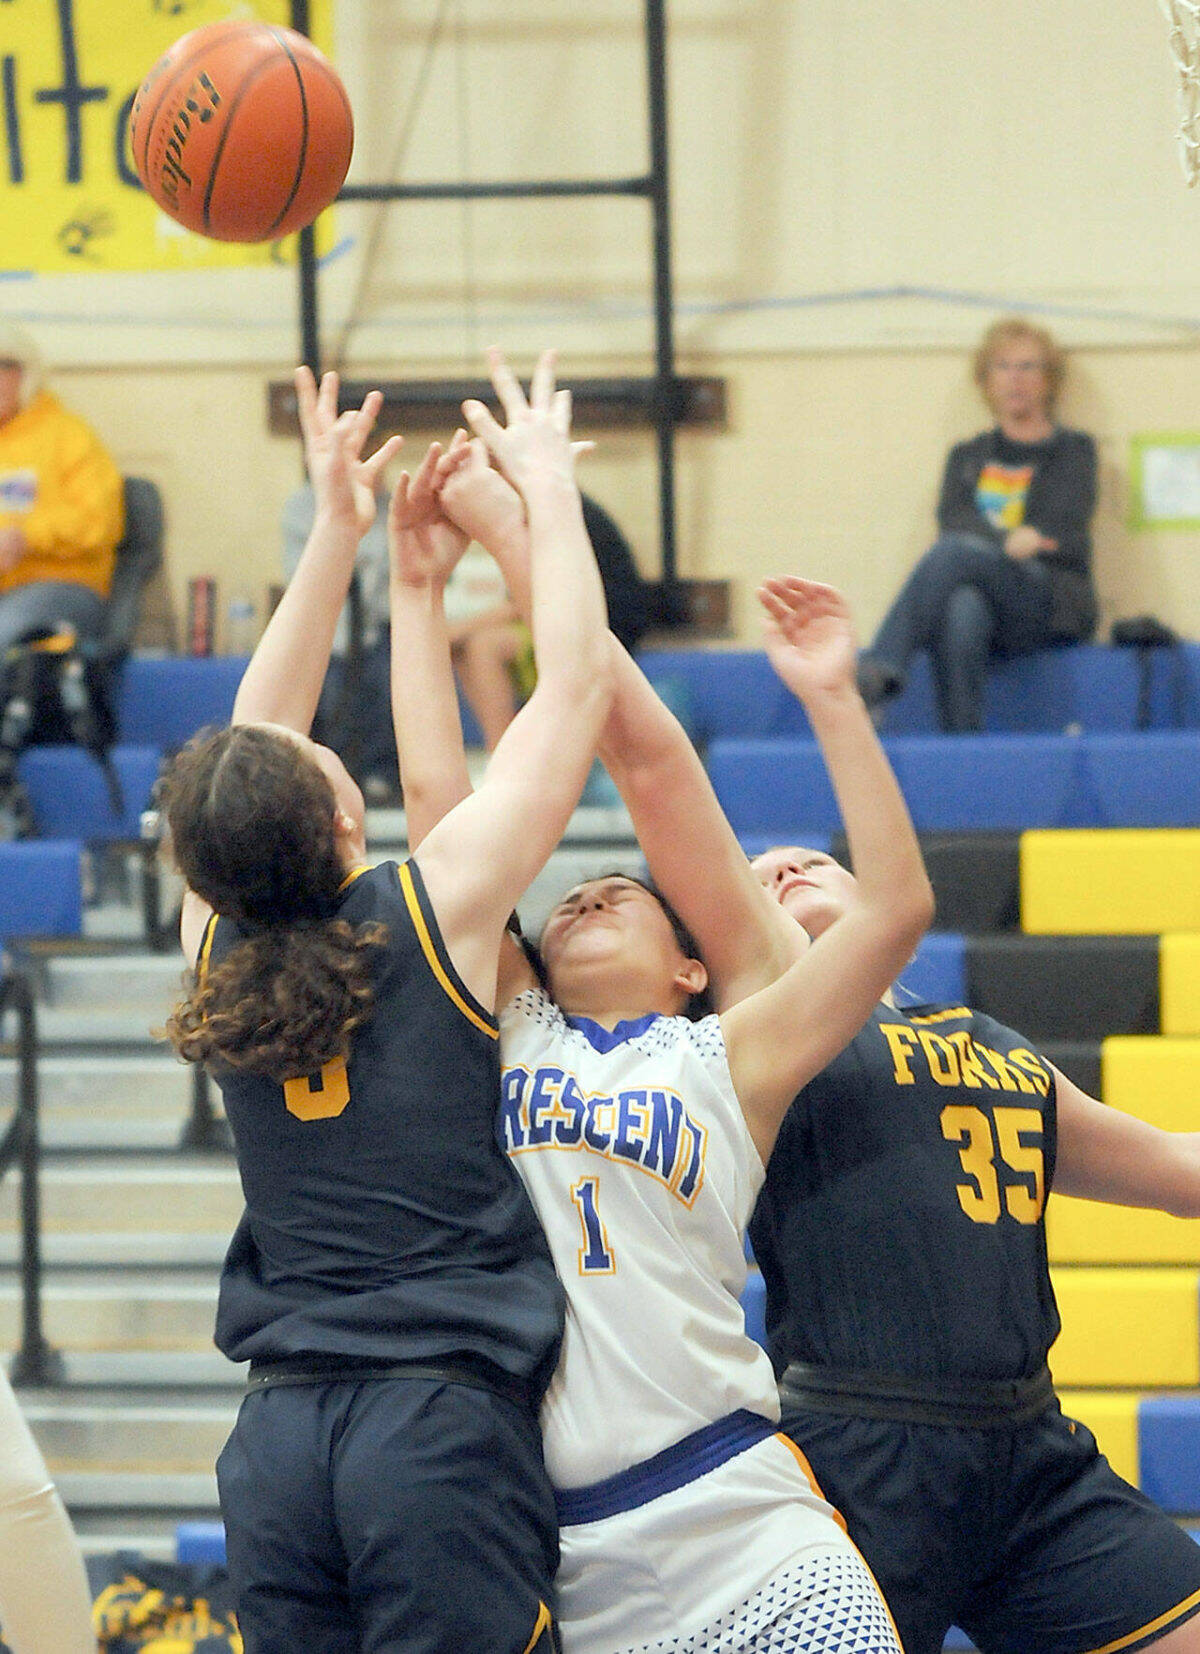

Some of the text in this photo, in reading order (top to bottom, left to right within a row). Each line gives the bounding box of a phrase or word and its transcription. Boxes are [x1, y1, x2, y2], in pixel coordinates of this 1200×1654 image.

[879, 1022, 1051, 1097] FORKS
[939, 1104, 1045, 1225] 35
[570, 1175, 616, 1277] 1
